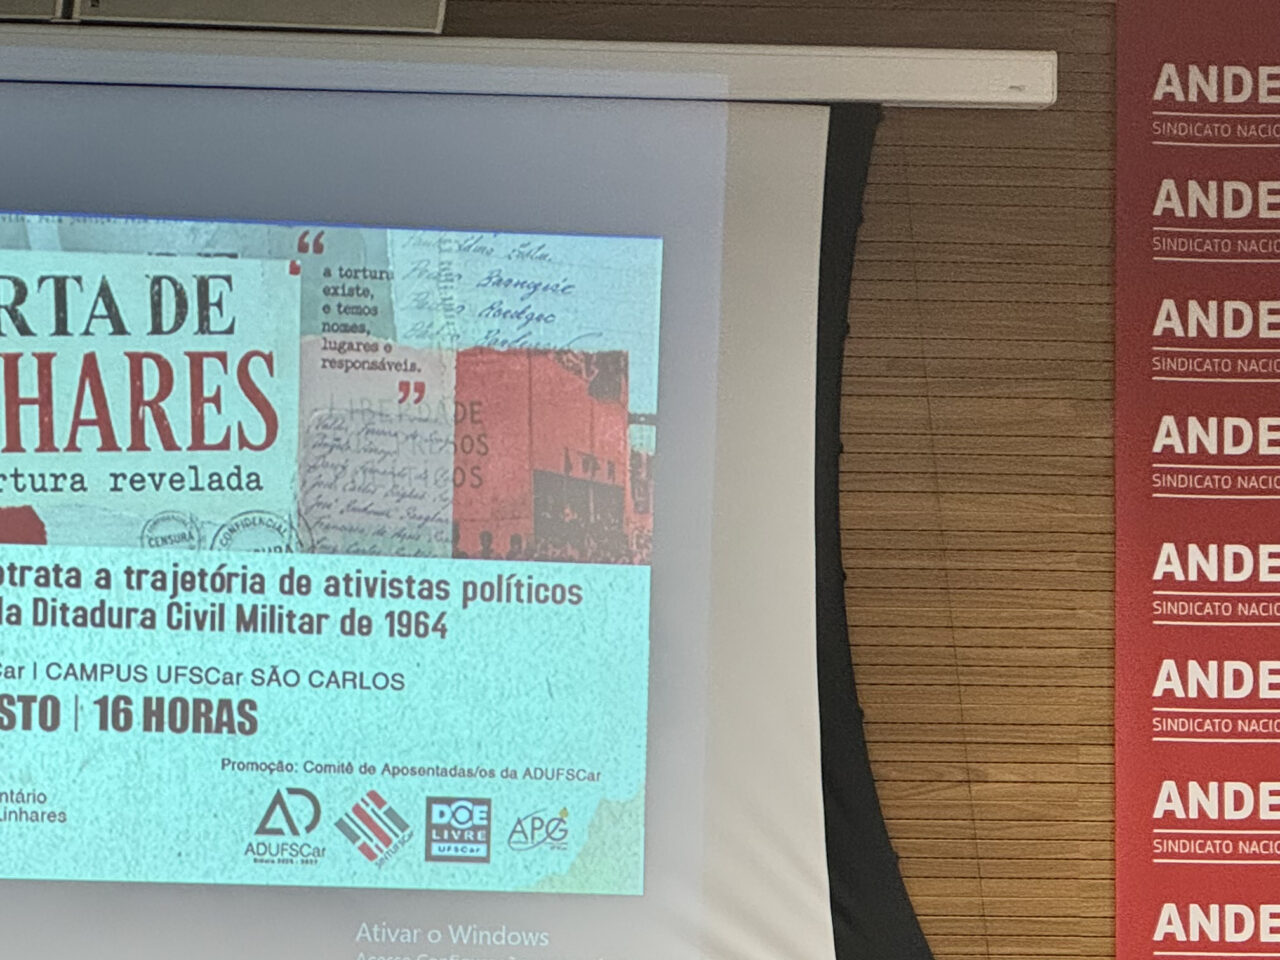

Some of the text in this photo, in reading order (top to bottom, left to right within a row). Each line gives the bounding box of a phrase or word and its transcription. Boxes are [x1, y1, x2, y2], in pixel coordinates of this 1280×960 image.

[1153, 121, 1231, 137] SINDICATO
[1153, 236, 1231, 253] SINDICATO
[323, 284, 374, 300] existe,
[145, 273, 237, 336] DE
[336, 303, 378, 316] temos
[322, 322, 371, 336] nomes,
[321, 337, 379, 354] lugares
[321, 357, 422, 374] responsáveis.
[109, 465, 263, 492] revelada
[1153, 473, 1231, 489] SINDICATO
[95, 568, 111, 590] a
[124, 562, 265, 600] trajetória
[279, 566, 311, 597] de
[324, 569, 449, 600] ativistas
[463, 573, 582, 610] políticos
[33, 597, 156, 630] Ditadura
[167, 602, 225, 632] Civil
[236, 603, 330, 635] Militar
[341, 607, 372, 637] de
[385, 610, 447, 639] 1964
[46, 662, 147, 683] CAMPUS
[157, 665, 243, 686] UFSCar
[251, 665, 300, 688] SÃO
[309, 669, 405, 691] CARLOS
[94, 694, 132, 733] 16
[143, 696, 257, 736] HORAS
[221, 758, 600, 782] Promoção: Comitê de Aposentadas/os da ADUFSCar
[431, 800, 489, 829] DCE
[431, 829, 487, 841] LIVRE
[244, 842, 327, 858] ADUFSCar
[1154, 839, 1232, 854] SINDICATO
[356, 922, 549, 947] Ativar o Windows
